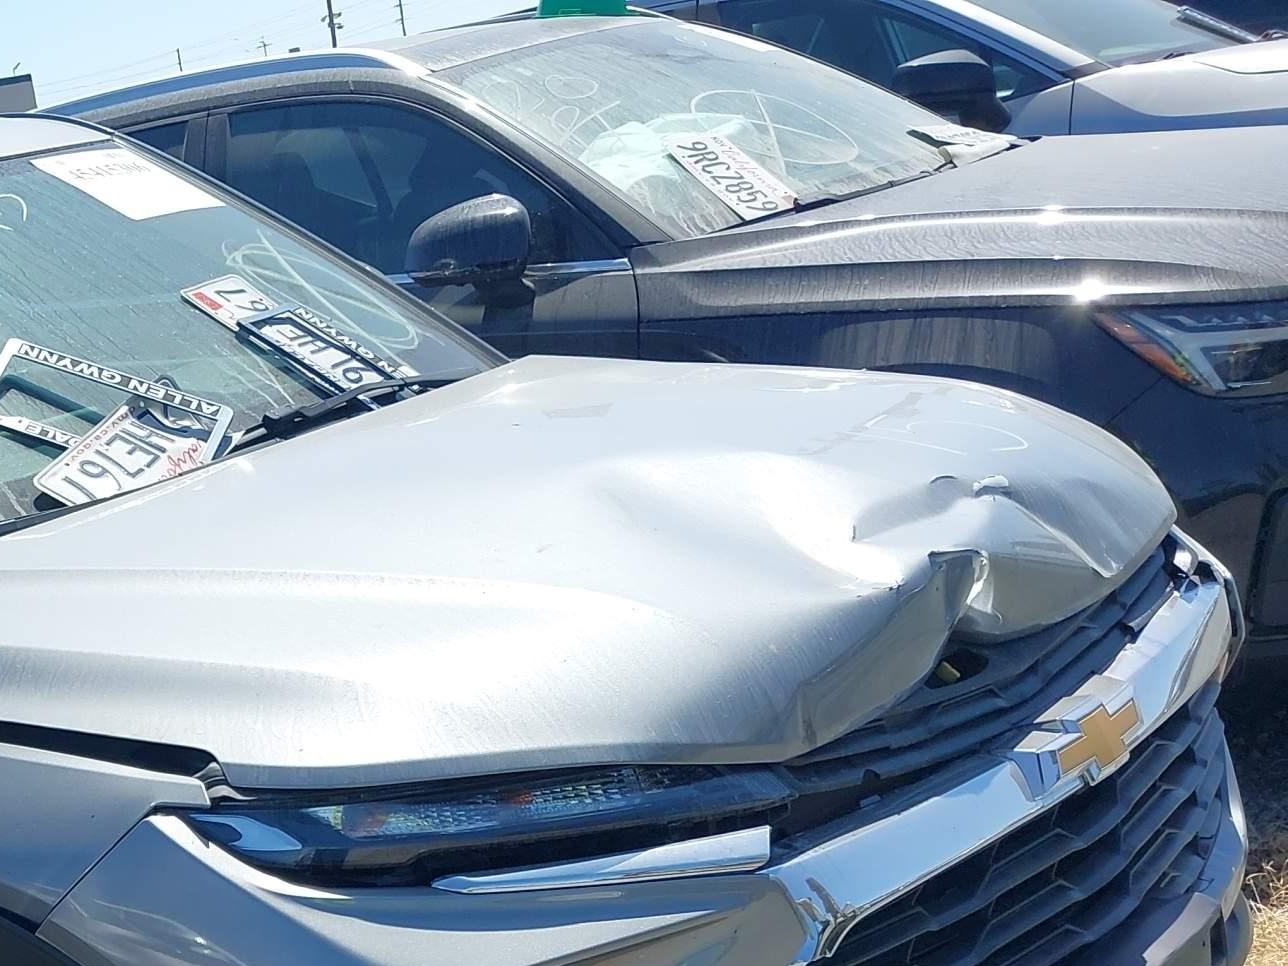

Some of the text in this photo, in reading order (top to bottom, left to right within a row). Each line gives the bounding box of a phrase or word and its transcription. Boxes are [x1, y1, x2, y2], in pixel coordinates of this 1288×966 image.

[676, 141, 779, 212] 9RCZ859
[295, 307, 376, 358] GWYNN
[20, 343, 221, 416] ALLEN GWYNN
[70, 406, 136, 463] dmv.ca.gov
